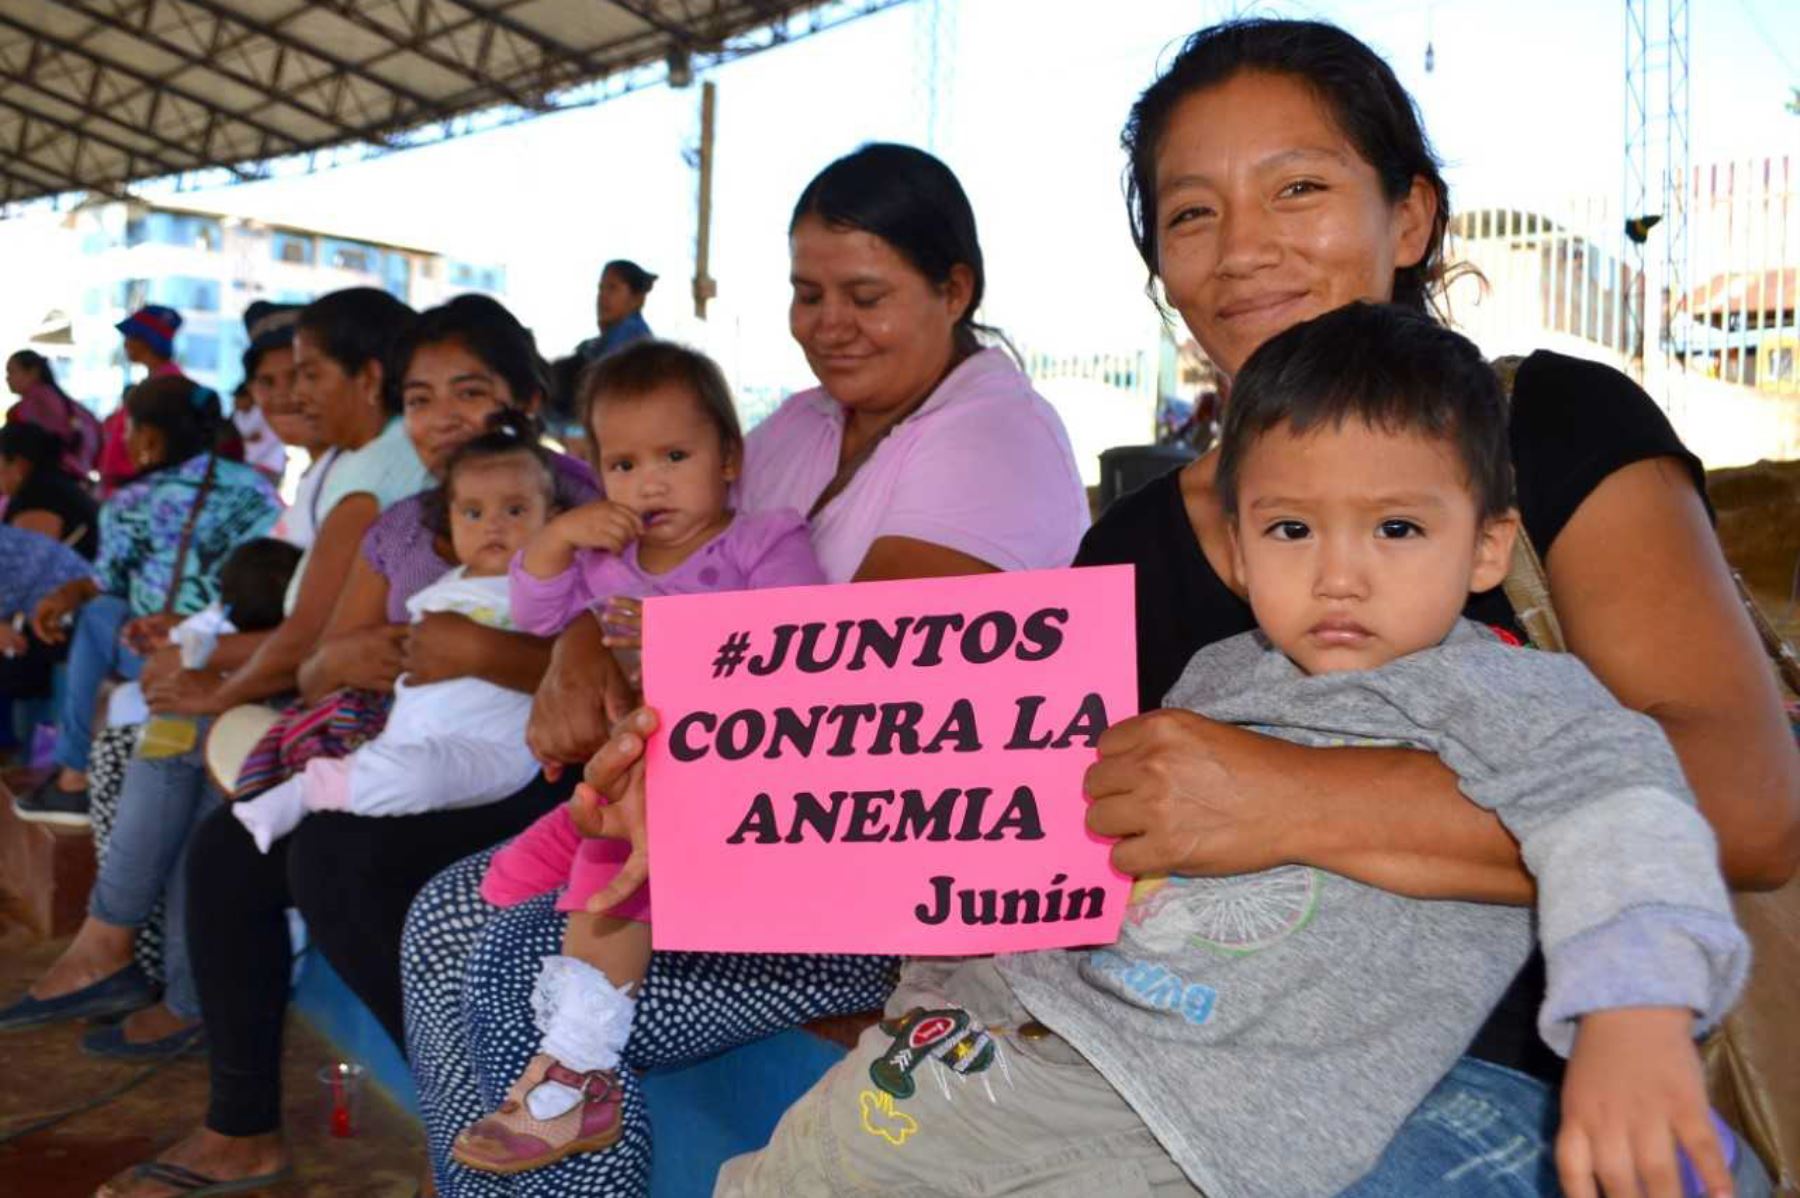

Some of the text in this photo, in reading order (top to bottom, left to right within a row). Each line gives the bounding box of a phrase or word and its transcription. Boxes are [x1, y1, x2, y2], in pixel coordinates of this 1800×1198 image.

[712, 608, 1069, 678] #JUNTOS
[668, 693, 1110, 762] CONTRA LA
[726, 785, 1045, 845] ANEMIA
[915, 873, 1106, 925] Junín
